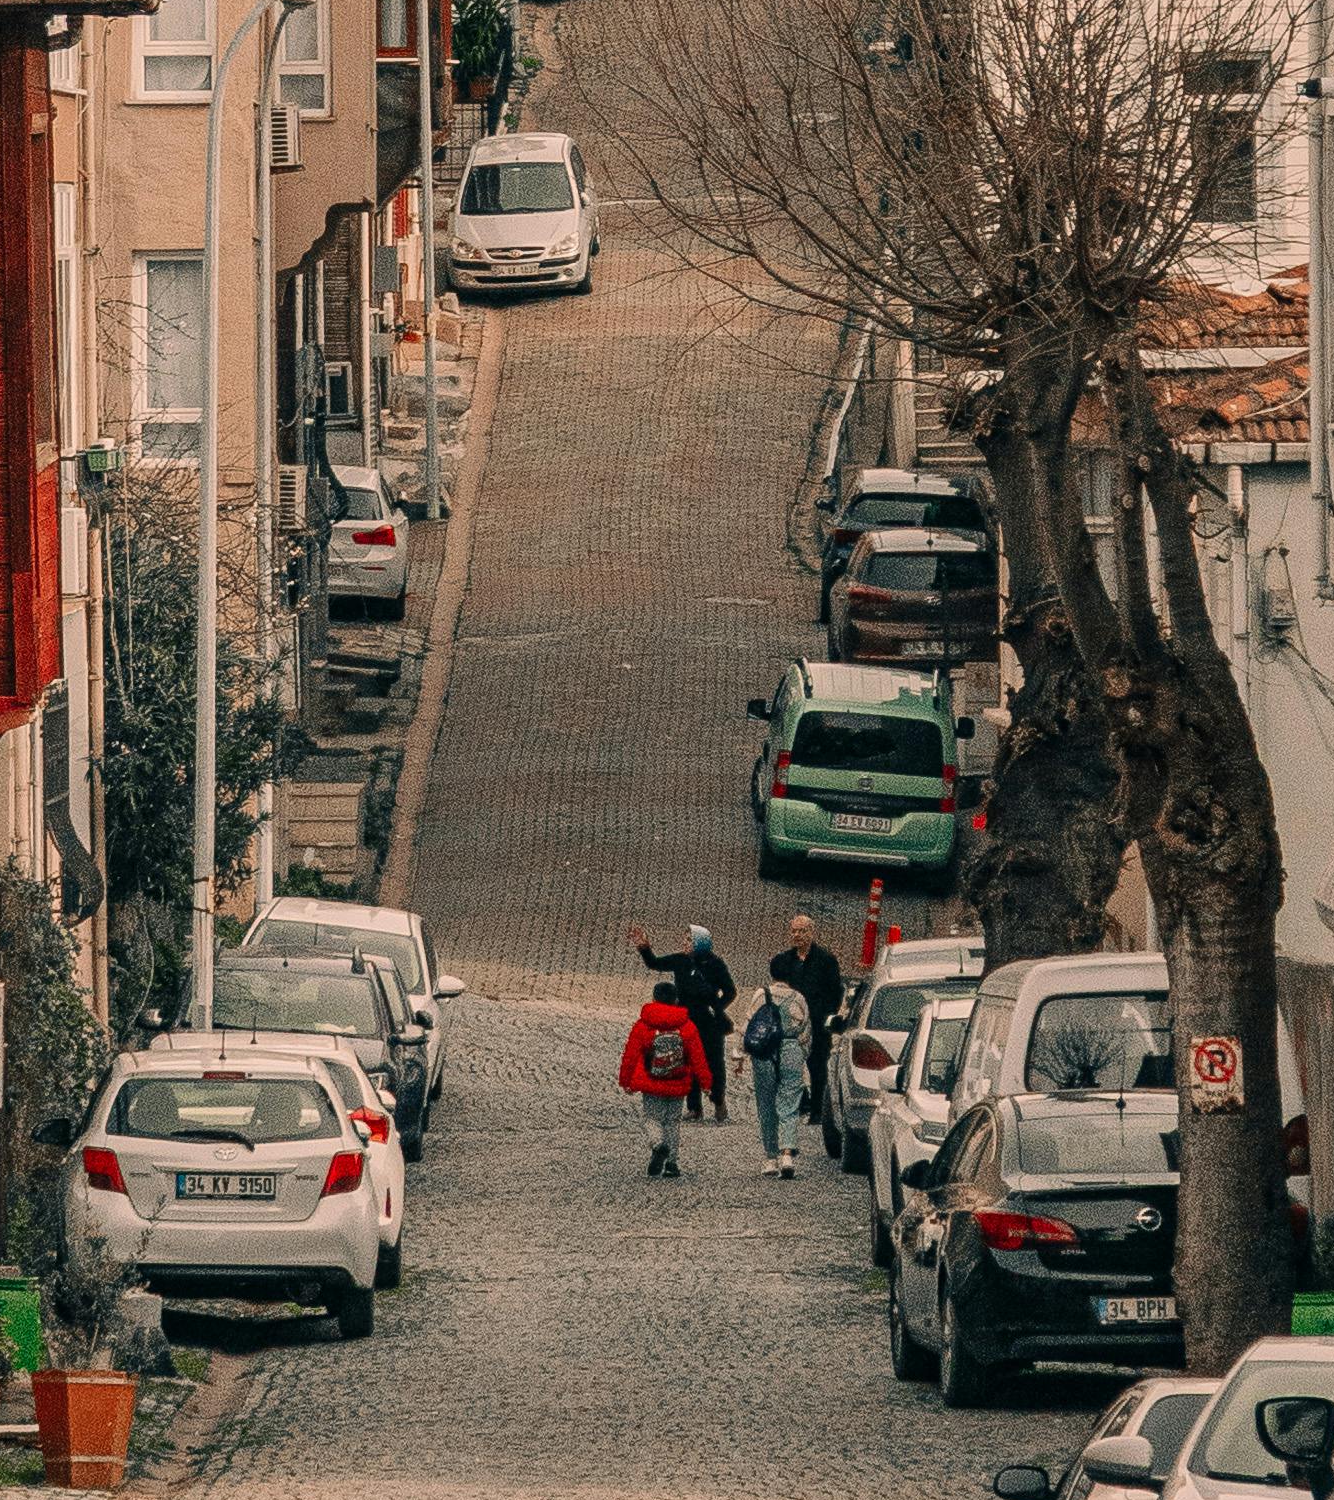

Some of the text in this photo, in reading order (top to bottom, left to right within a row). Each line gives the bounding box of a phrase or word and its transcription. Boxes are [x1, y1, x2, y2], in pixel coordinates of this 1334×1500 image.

[187, 1175, 272, 1193] 34 KV 9150
[1108, 1300, 1167, 1319] 34 BPH
